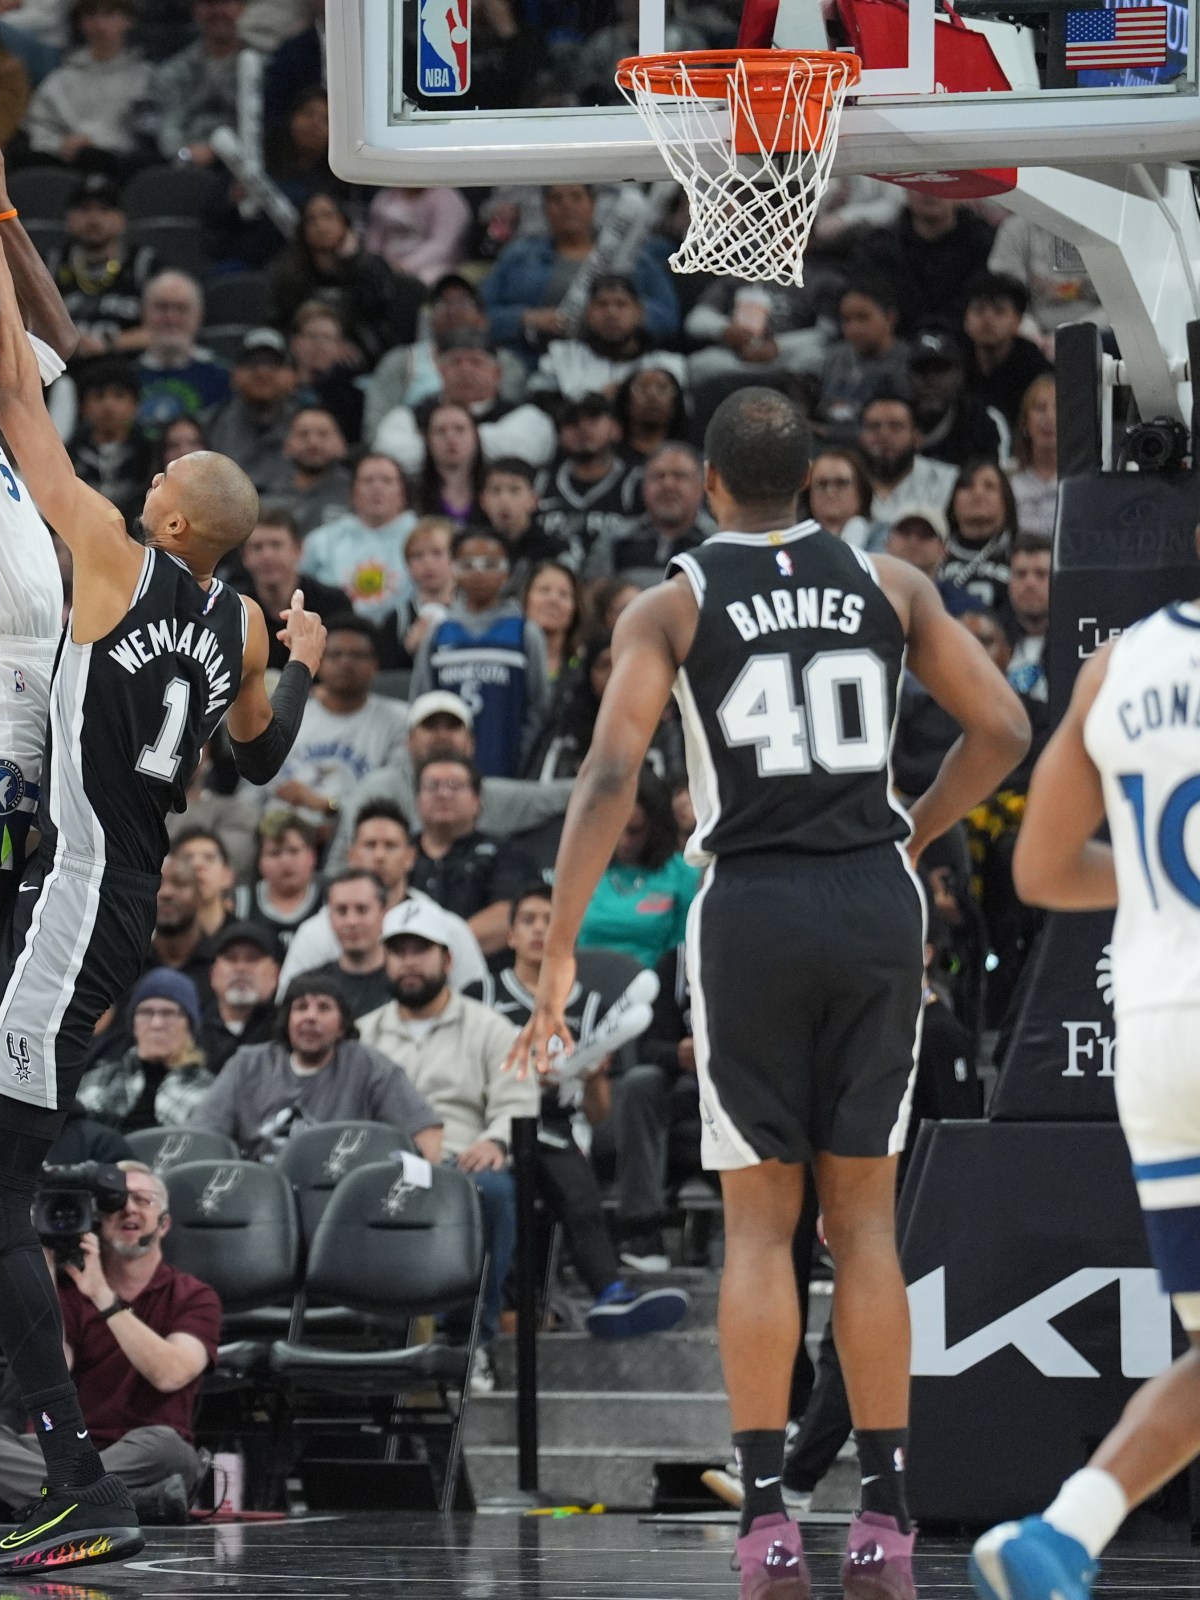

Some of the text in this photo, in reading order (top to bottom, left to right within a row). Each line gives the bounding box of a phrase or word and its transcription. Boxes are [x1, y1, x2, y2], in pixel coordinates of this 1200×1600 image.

[425, 68, 450, 88] NBA
[725, 586, 866, 642] BARNES
[108, 617, 231, 716] WEMANYAMA
[134, 676, 190, 783] 1
[715, 647, 890, 779] 40
[3, 760, 25, 808] TIMBERWOLVES
